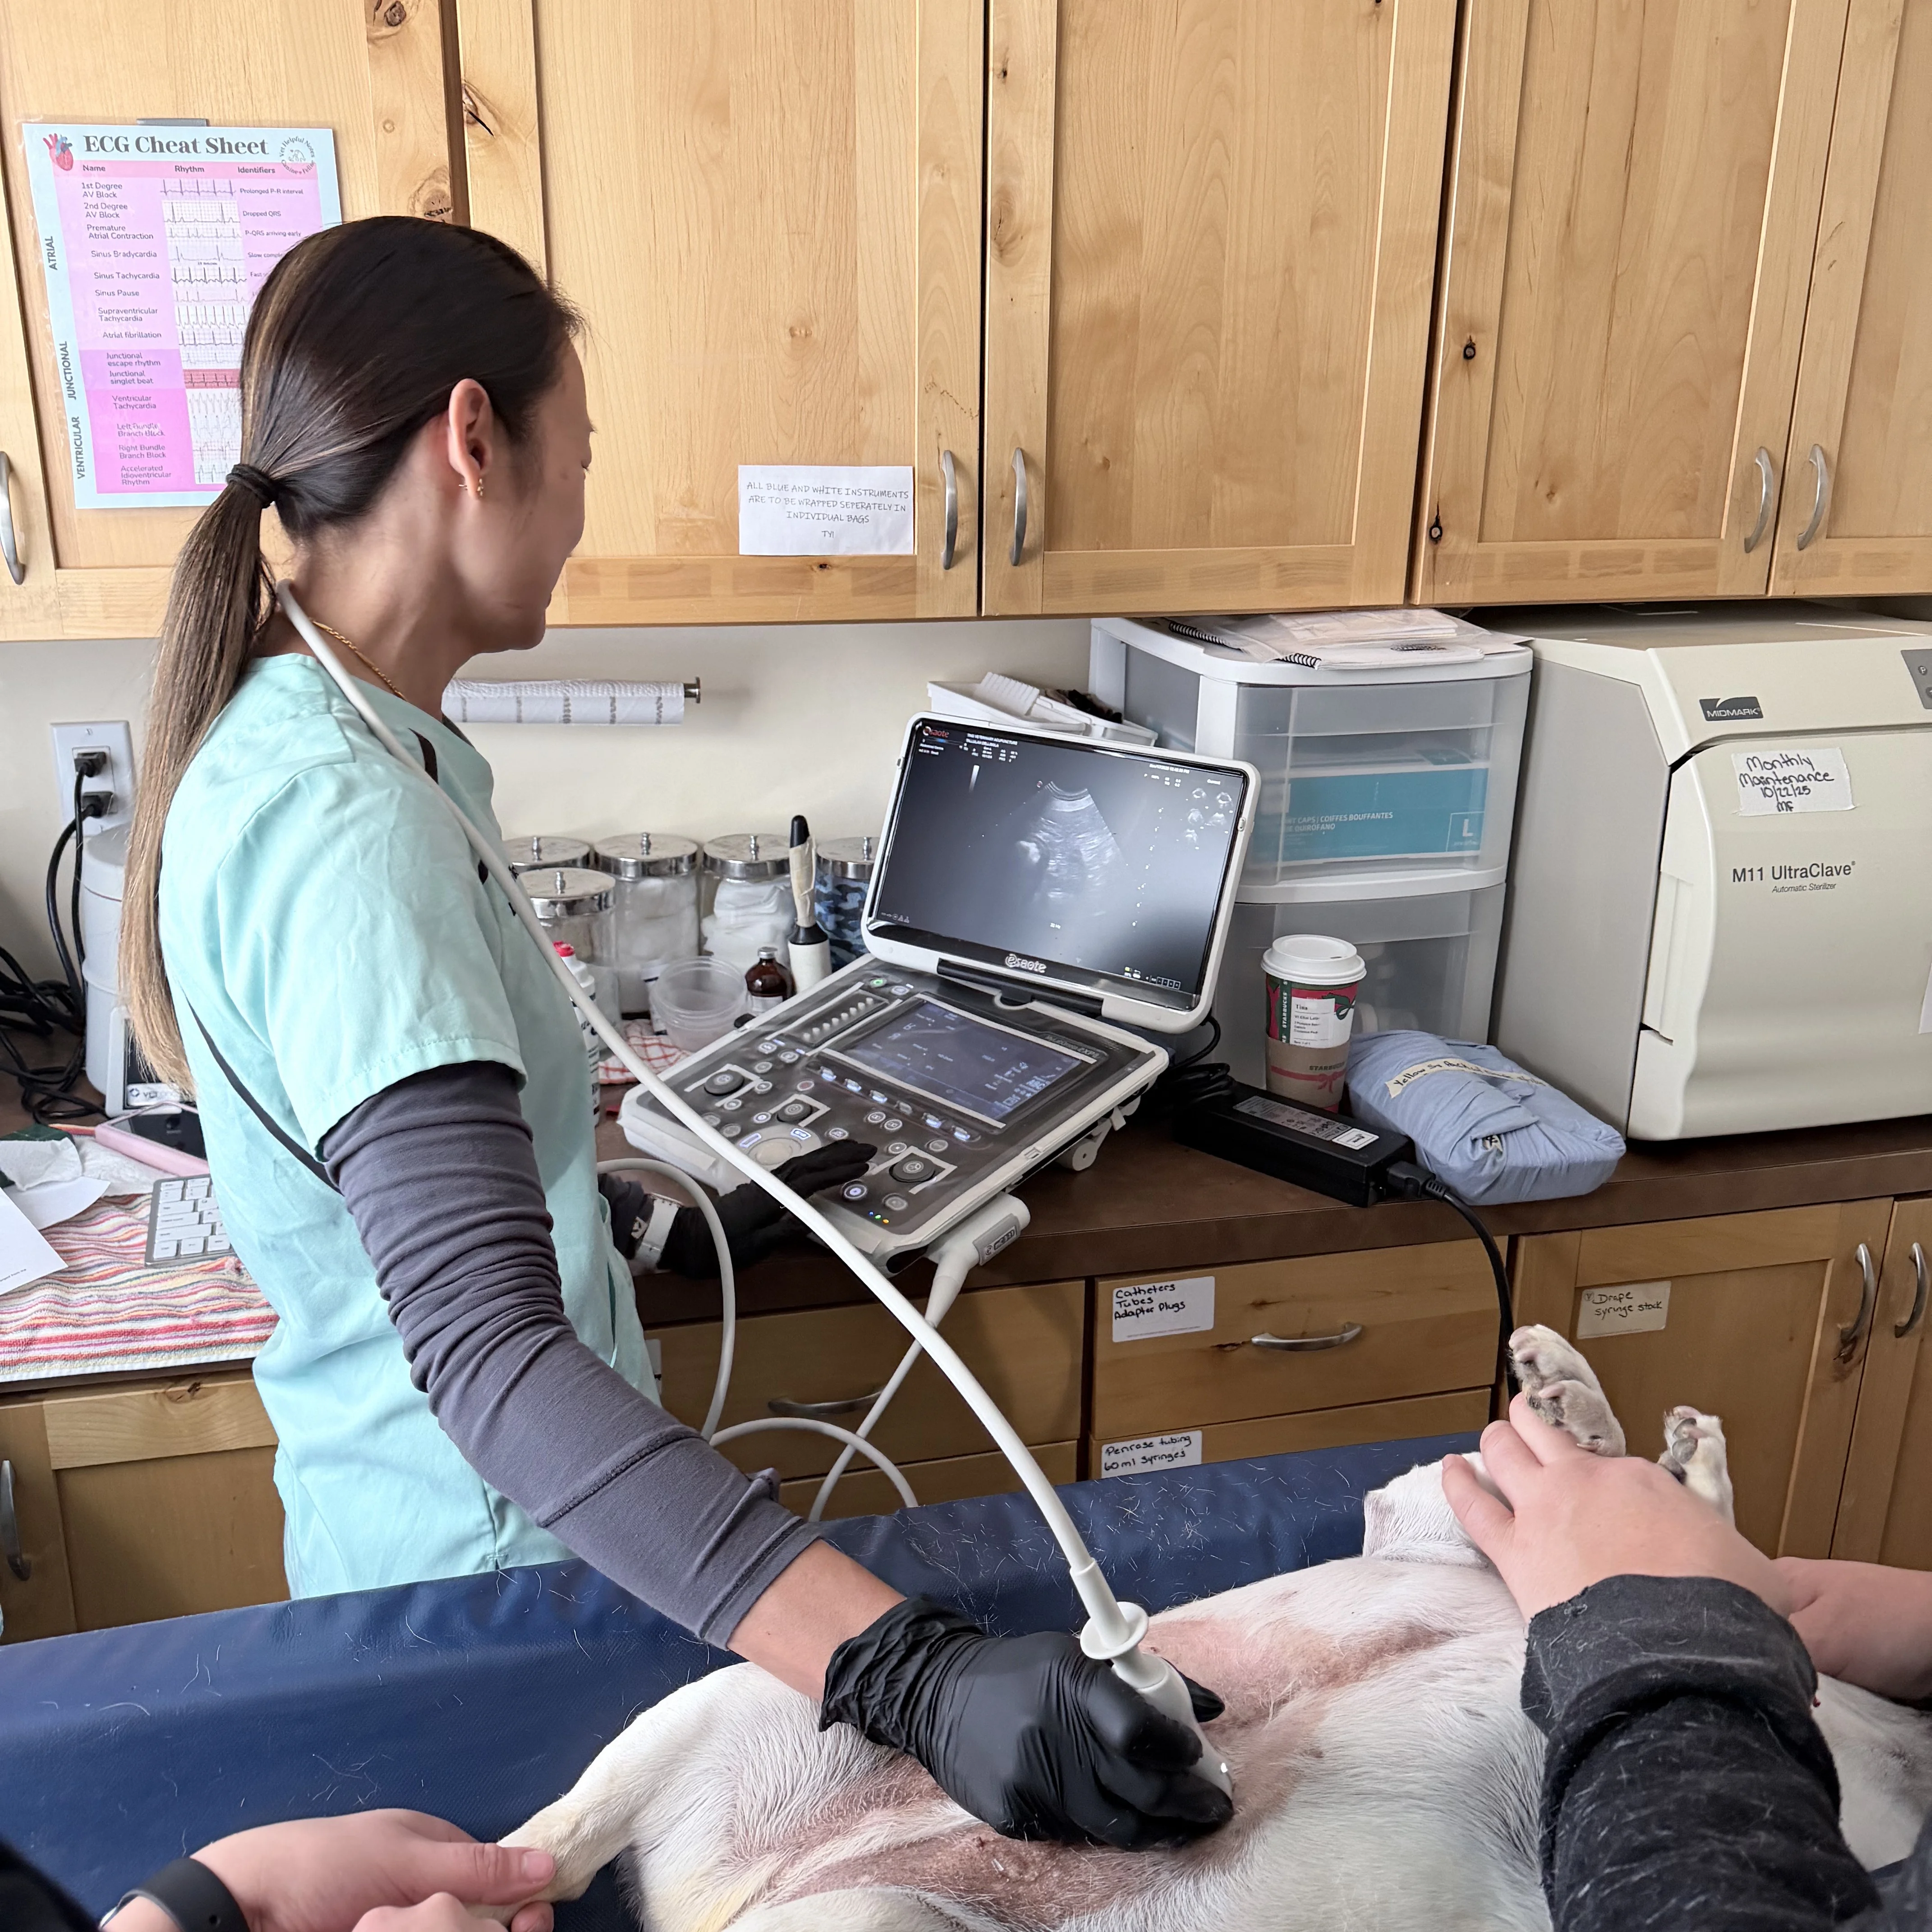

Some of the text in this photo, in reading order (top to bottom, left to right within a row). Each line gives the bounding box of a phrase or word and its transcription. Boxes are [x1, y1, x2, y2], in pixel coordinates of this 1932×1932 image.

[83, 135, 270, 155] ECG Cheat Sheet
[282, 135, 304, 147] Helpful
[304, 140, 315, 157] Notes
[175, 165, 205, 174] Rhythm
[95, 182, 123, 191] Degree
[101, 203, 128, 211] Degree
[86, 224, 126, 232] Premature
[45, 236, 58, 271] ATRIAL
[113, 250, 157, 259] Bradycardia
[115, 272, 160, 280] Tachycardia
[98, 307, 158, 315] Supraventricular
[98, 315, 143, 323] Tachycardia
[59, 340, 77, 400] JUNCTIONAL
[113, 402, 157, 410] Tachycardia
[71, 416, 85, 480] VENTRICULAR
[119, 444, 138, 453] Right
[746, 481, 909, 499] ALL BLUE AND WHITE INSTRUMENTS
[748, 494, 906, 512] ARE TO BE WRAPPED SEPERATELY IN
[786, 511, 869, 524] INDIVIDUAL BAGS
[1707, 708, 1758, 718] MIDMARK
[1746, 753, 1815, 772] Monthly
[1739, 771, 1835, 787] Maintenance
[1760, 784, 1811, 801] 10/22/25
[1320, 814, 1348, 823] COIFFES
[1348, 811, 1394, 821] BOUFFANTES
[1462, 819, 1474, 837] L
[1732, 866, 1764, 883] M11
[1771, 883, 1837, 893] Automatic Sterilizer
[1393, 1068, 1426, 1086] Yellow
[1115, 1284, 1176, 1299] Catheters
[1592, 1291, 1633, 1304] Drape
[1116, 1297, 1154, 1308] Tubes
[1114, 1301, 1186, 1320] Adapter Plugs
[1594, 1301, 1662, 1320] syringe stock
[1105, 1435, 1192, 1456] Penrose tubing
